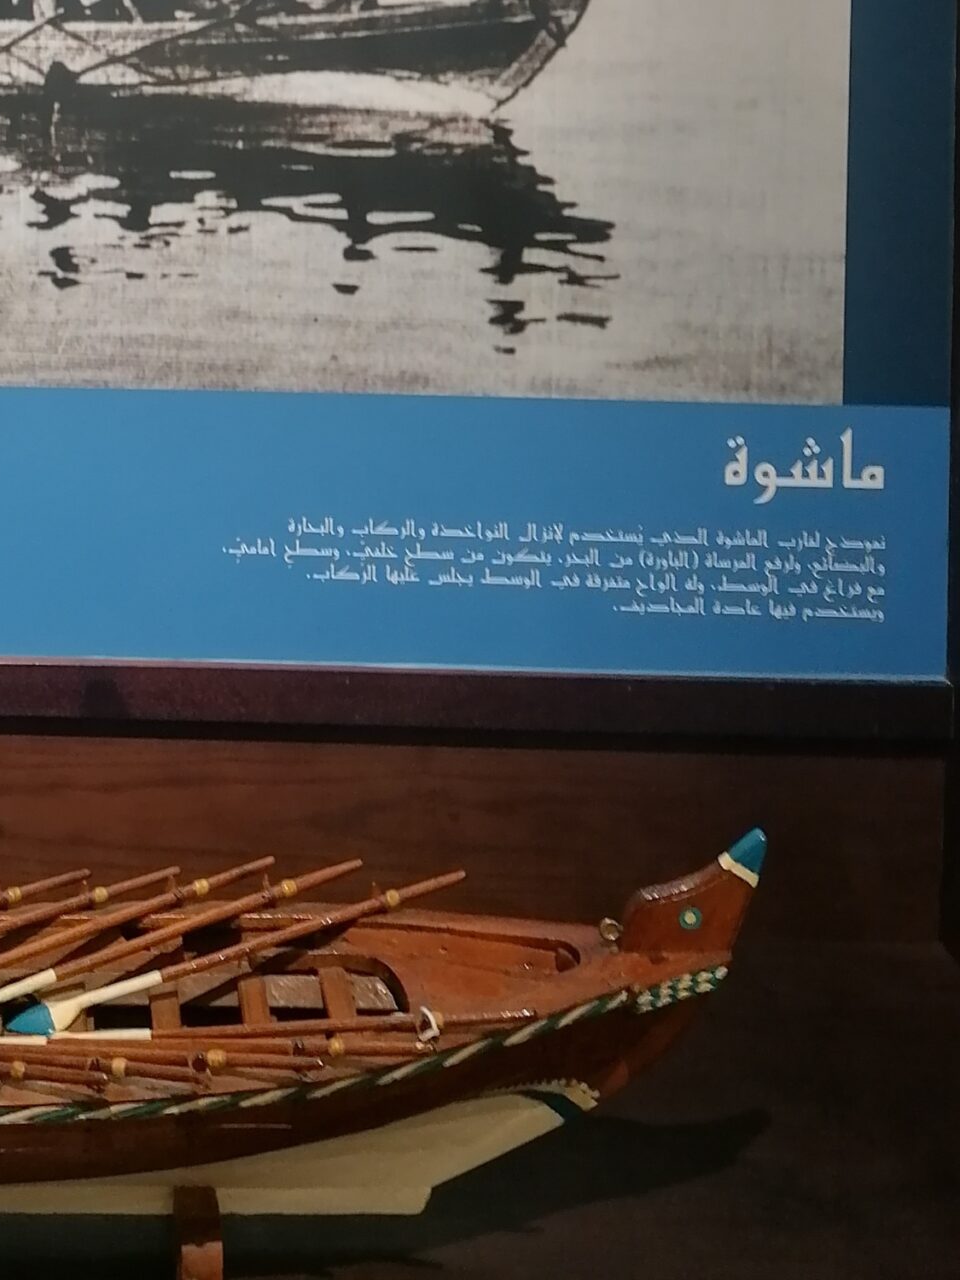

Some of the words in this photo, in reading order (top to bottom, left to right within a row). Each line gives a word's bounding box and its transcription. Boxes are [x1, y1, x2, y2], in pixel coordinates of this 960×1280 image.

[724, 426, 885, 505] ماشوة
[288, 516, 344, 537] والبحارة
[351, 518, 426, 539] والركاب
[649, 527, 708, 547] الذي
[716, 528, 768, 549] الماشوة
[460, 549, 485, 564] من
[491, 547, 552, 567] يتكون
[609, 553, 633, 568] من
[704, 552, 757, 573] المرساة
[385, 563, 420, 585] عليها
[428, 566, 473, 587] يجلس
[480, 567, 543, 589] الوسط
[550, 571, 581, 590] في
[684, 574, 705, 595] وله
[787, 580, 818, 597] في
[823, 578, 862, 602] فراغ
[866, 584, 885, 604] مع
[712, 598, 762, 617] عادة
[769, 598, 796, 620] فيها
